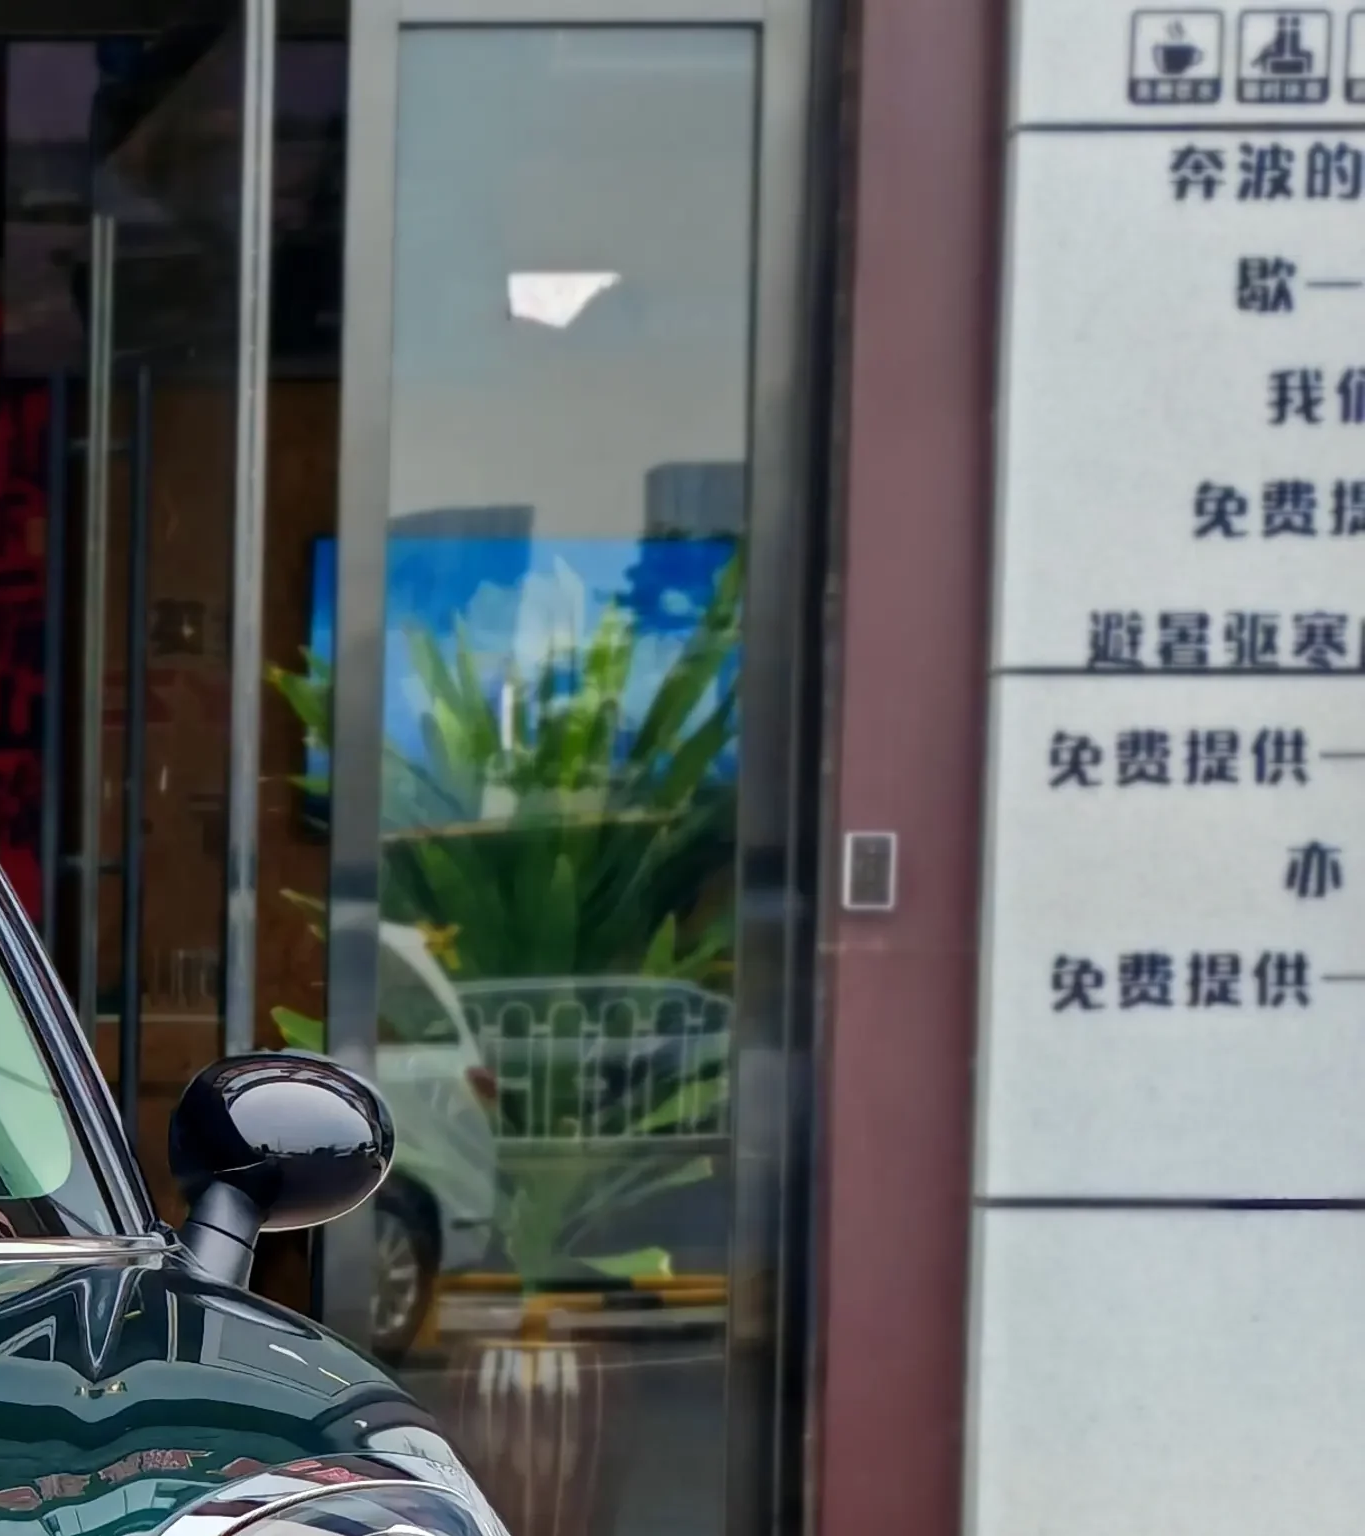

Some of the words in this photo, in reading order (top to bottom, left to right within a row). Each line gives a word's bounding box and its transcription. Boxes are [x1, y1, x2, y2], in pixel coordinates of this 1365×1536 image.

[1170, 142, 1365, 201] 奔波的
[1087, 609, 1365, 669] 避暑驱寒
[1284, 840, 1344, 900] 亦
